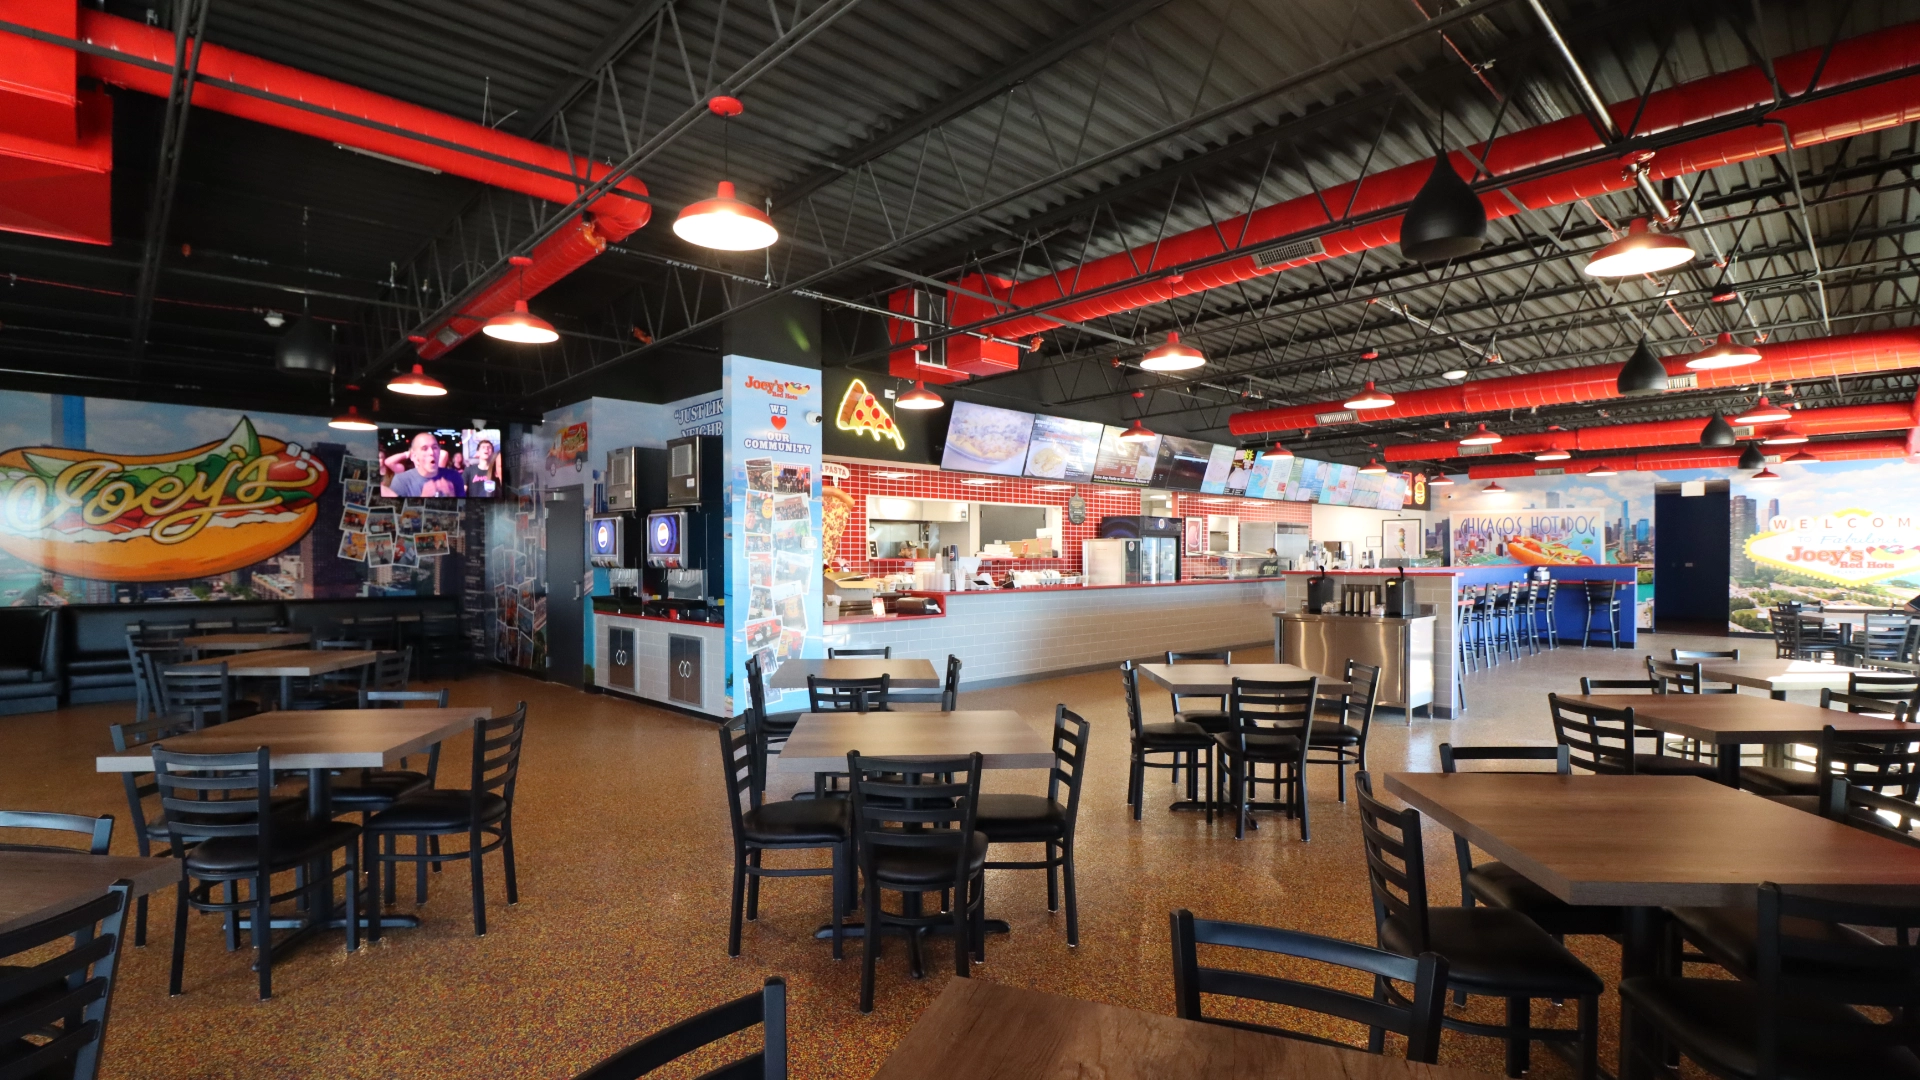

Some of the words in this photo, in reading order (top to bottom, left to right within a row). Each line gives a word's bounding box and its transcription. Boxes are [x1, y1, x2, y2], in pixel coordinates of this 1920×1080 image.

[745, 375, 784, 394] Joey's
[785, 393, 798, 401] Hots
[769, 403, 787, 415] WE
[767, 431, 790, 443] OUR
[744, 438, 812, 454] COMMUNITY
[825, 465, 847, 477] PASTA
[4, 444, 320, 544] Joey's
[1460, 516, 1522, 536] CHICAGO'S
[1531, 515, 1560, 535] HOT
[1567, 515, 1596, 537] DOG
[1820, 532, 1899, 545] Fabulous
[1786, 545, 1865, 566] Joey's
[1840, 561, 1864, 569] Red
[1867, 561, 1895, 569] Hots
